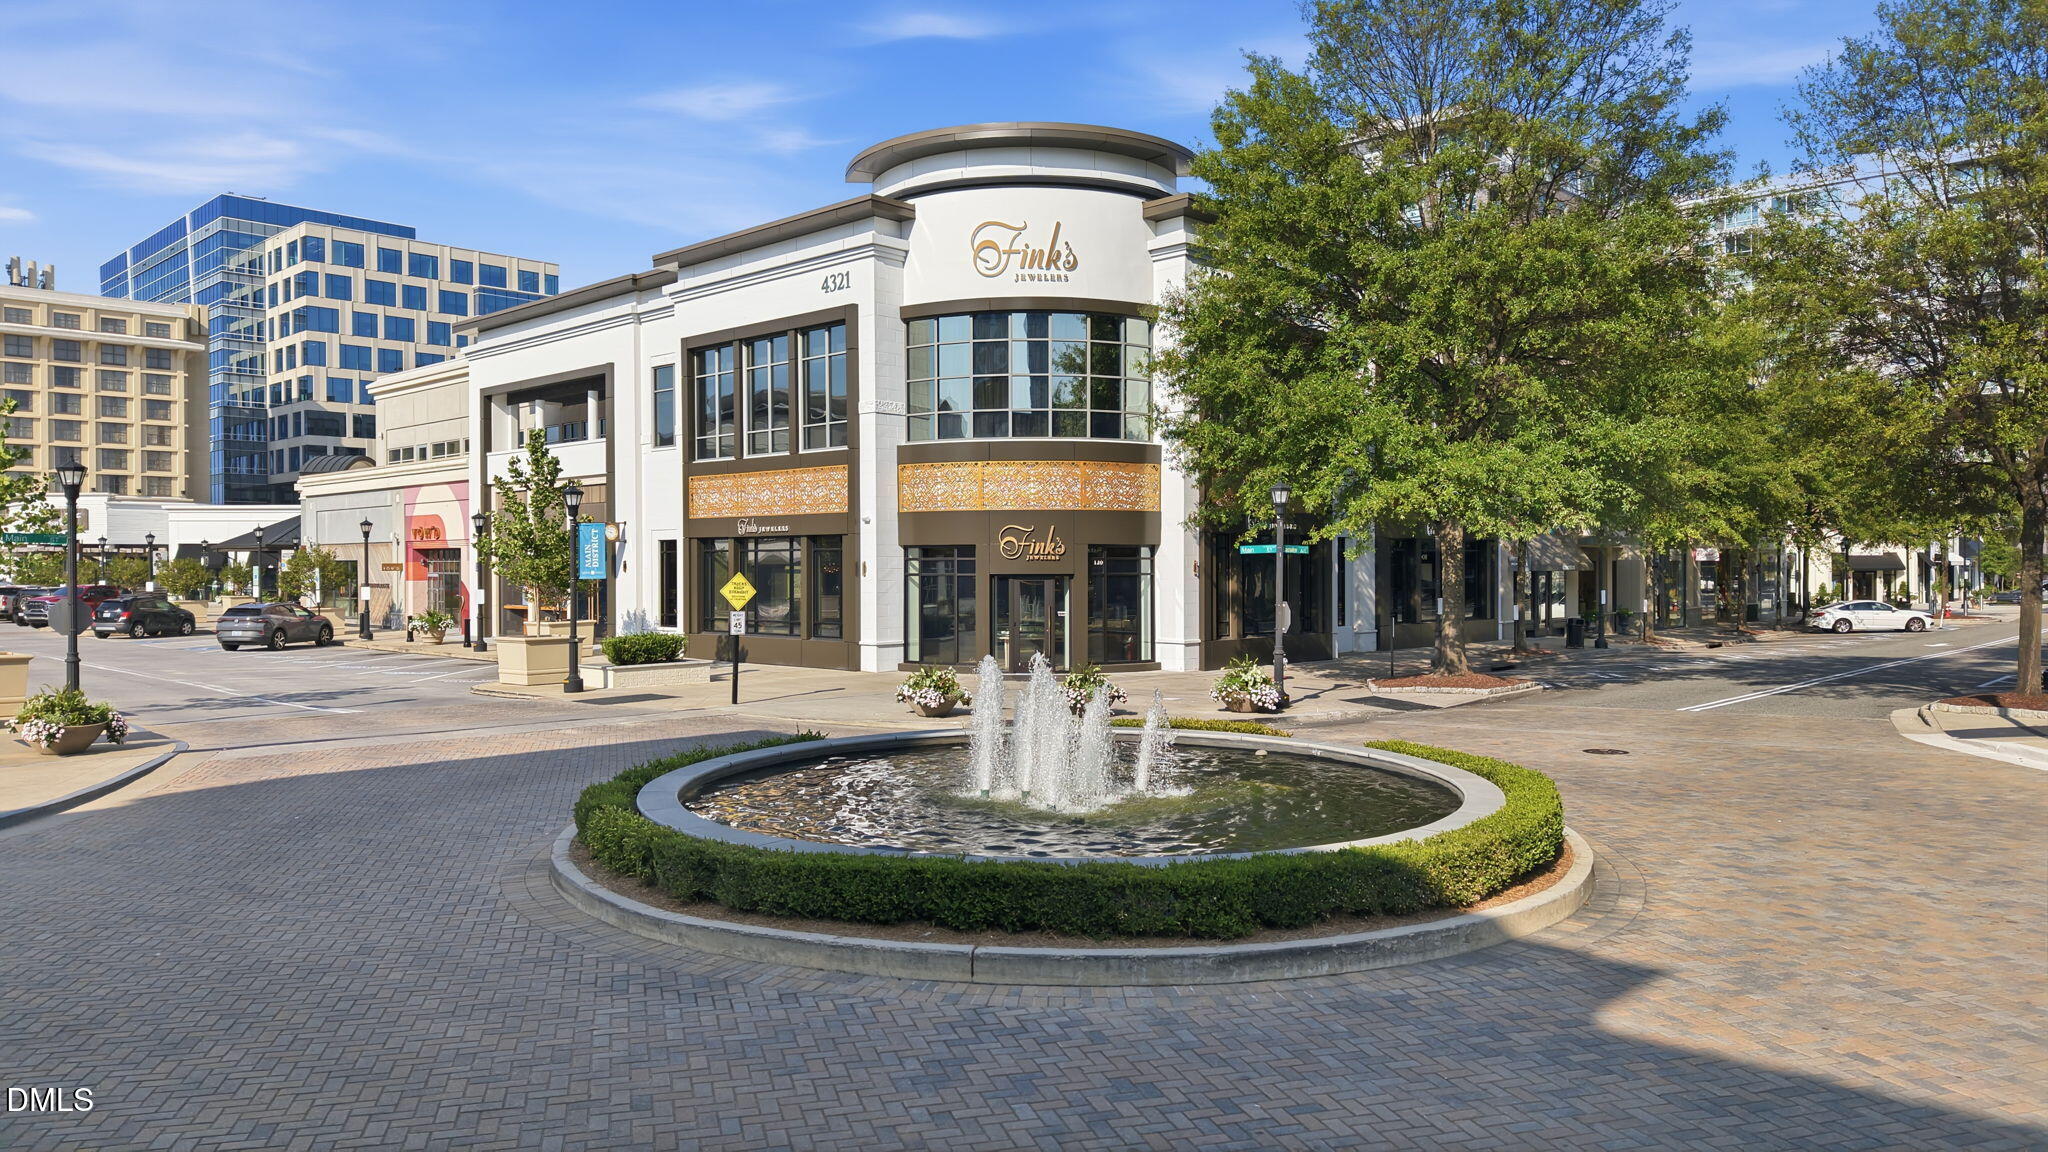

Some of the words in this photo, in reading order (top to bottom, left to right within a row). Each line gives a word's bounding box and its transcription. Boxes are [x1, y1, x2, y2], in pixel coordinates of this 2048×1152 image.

[971, 220, 1078, 278] Fink's
[821, 270, 851, 293] 4321
[1014, 273, 1069, 283] JEWELERS
[5, 534, 28, 543] Main
[591, 528, 599, 568] DISTRICT
[998, 524, 1066, 559] Fink's
[584, 544, 592, 568] MAIN
